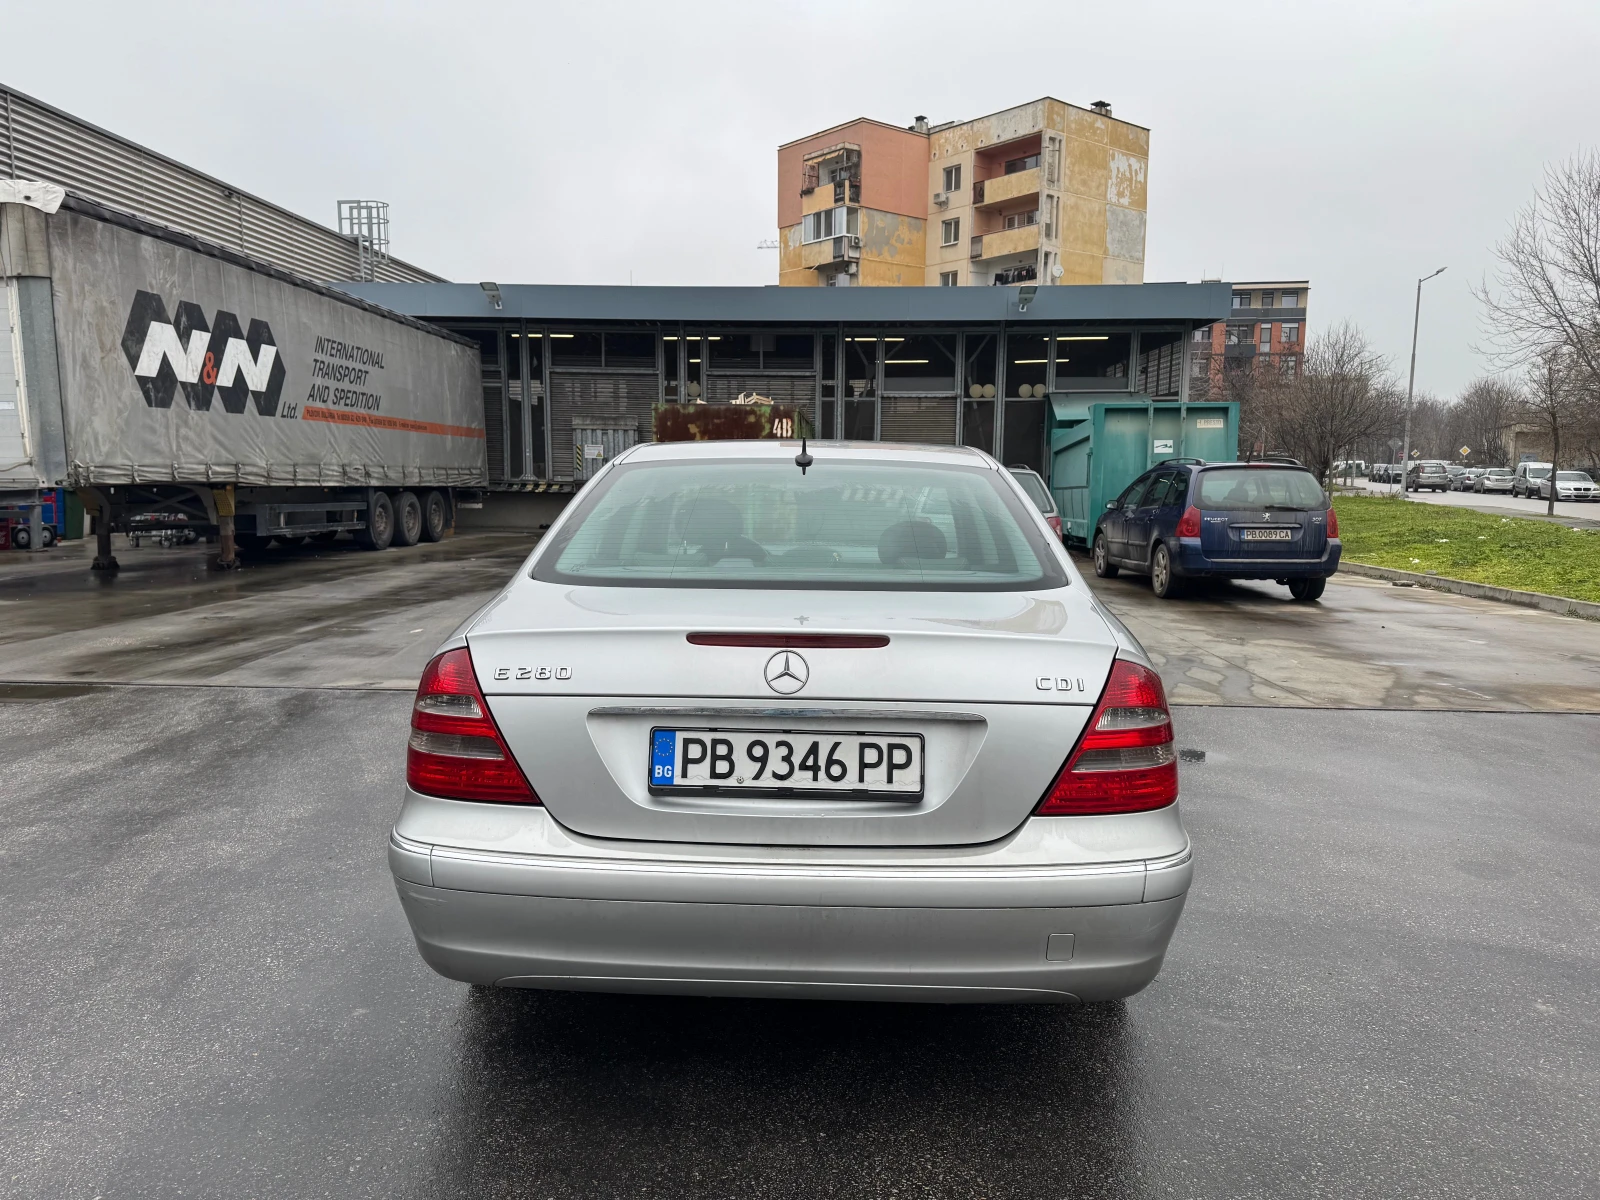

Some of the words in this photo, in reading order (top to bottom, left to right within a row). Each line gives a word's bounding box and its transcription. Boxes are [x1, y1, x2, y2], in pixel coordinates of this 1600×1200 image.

[315, 335, 384, 369] INTERNATIONAL
[312, 358, 369, 386] TRANSPORT
[307, 383, 330, 403] AND
[332, 387, 381, 411] SPEDITION
[281, 401, 298, 419] Ltd.
[1279, 530, 1290, 539] CA
[494, 667, 510, 680] E
[516, 666, 572, 680] 280
[1035, 676, 1085, 692] CDI
[654, 765, 672, 778] BG
[680, 737, 736, 780] PB
[746, 739, 848, 783] 9346
[858, 742, 913, 784] PP
